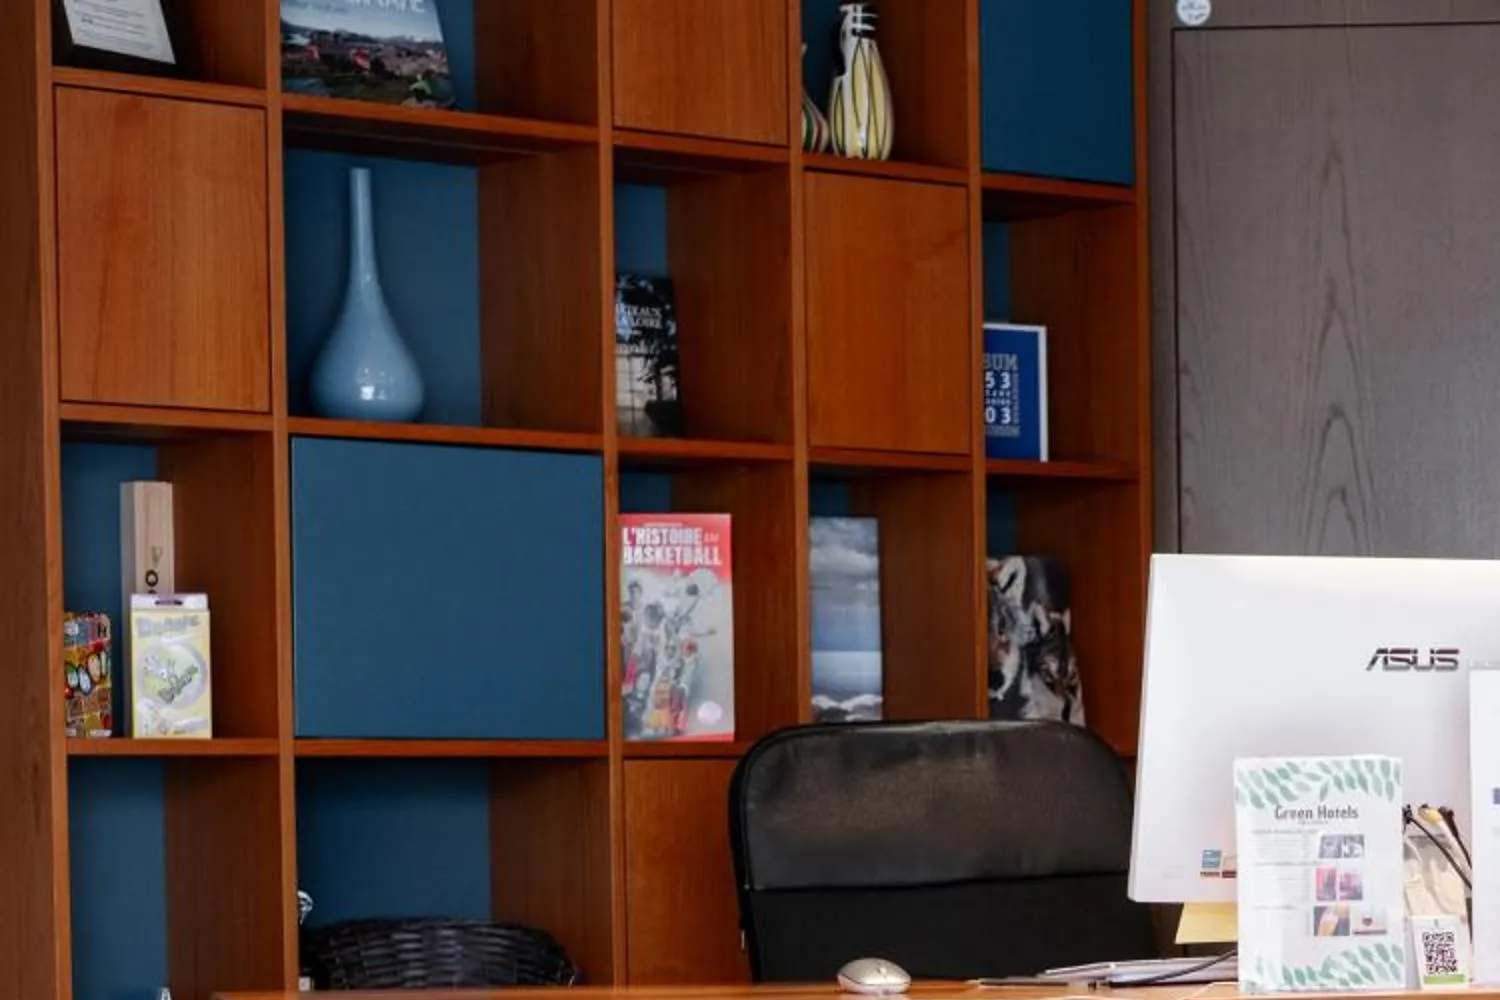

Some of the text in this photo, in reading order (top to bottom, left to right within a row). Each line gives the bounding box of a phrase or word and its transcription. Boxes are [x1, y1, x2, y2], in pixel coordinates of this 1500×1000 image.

[623, 527, 702, 546] L'HISTOIRE
[623, 546, 721, 565] BASKETBALL
[1366, 648, 1459, 672] ASUS
[1274, 804, 1359, 820] Green Hotels
